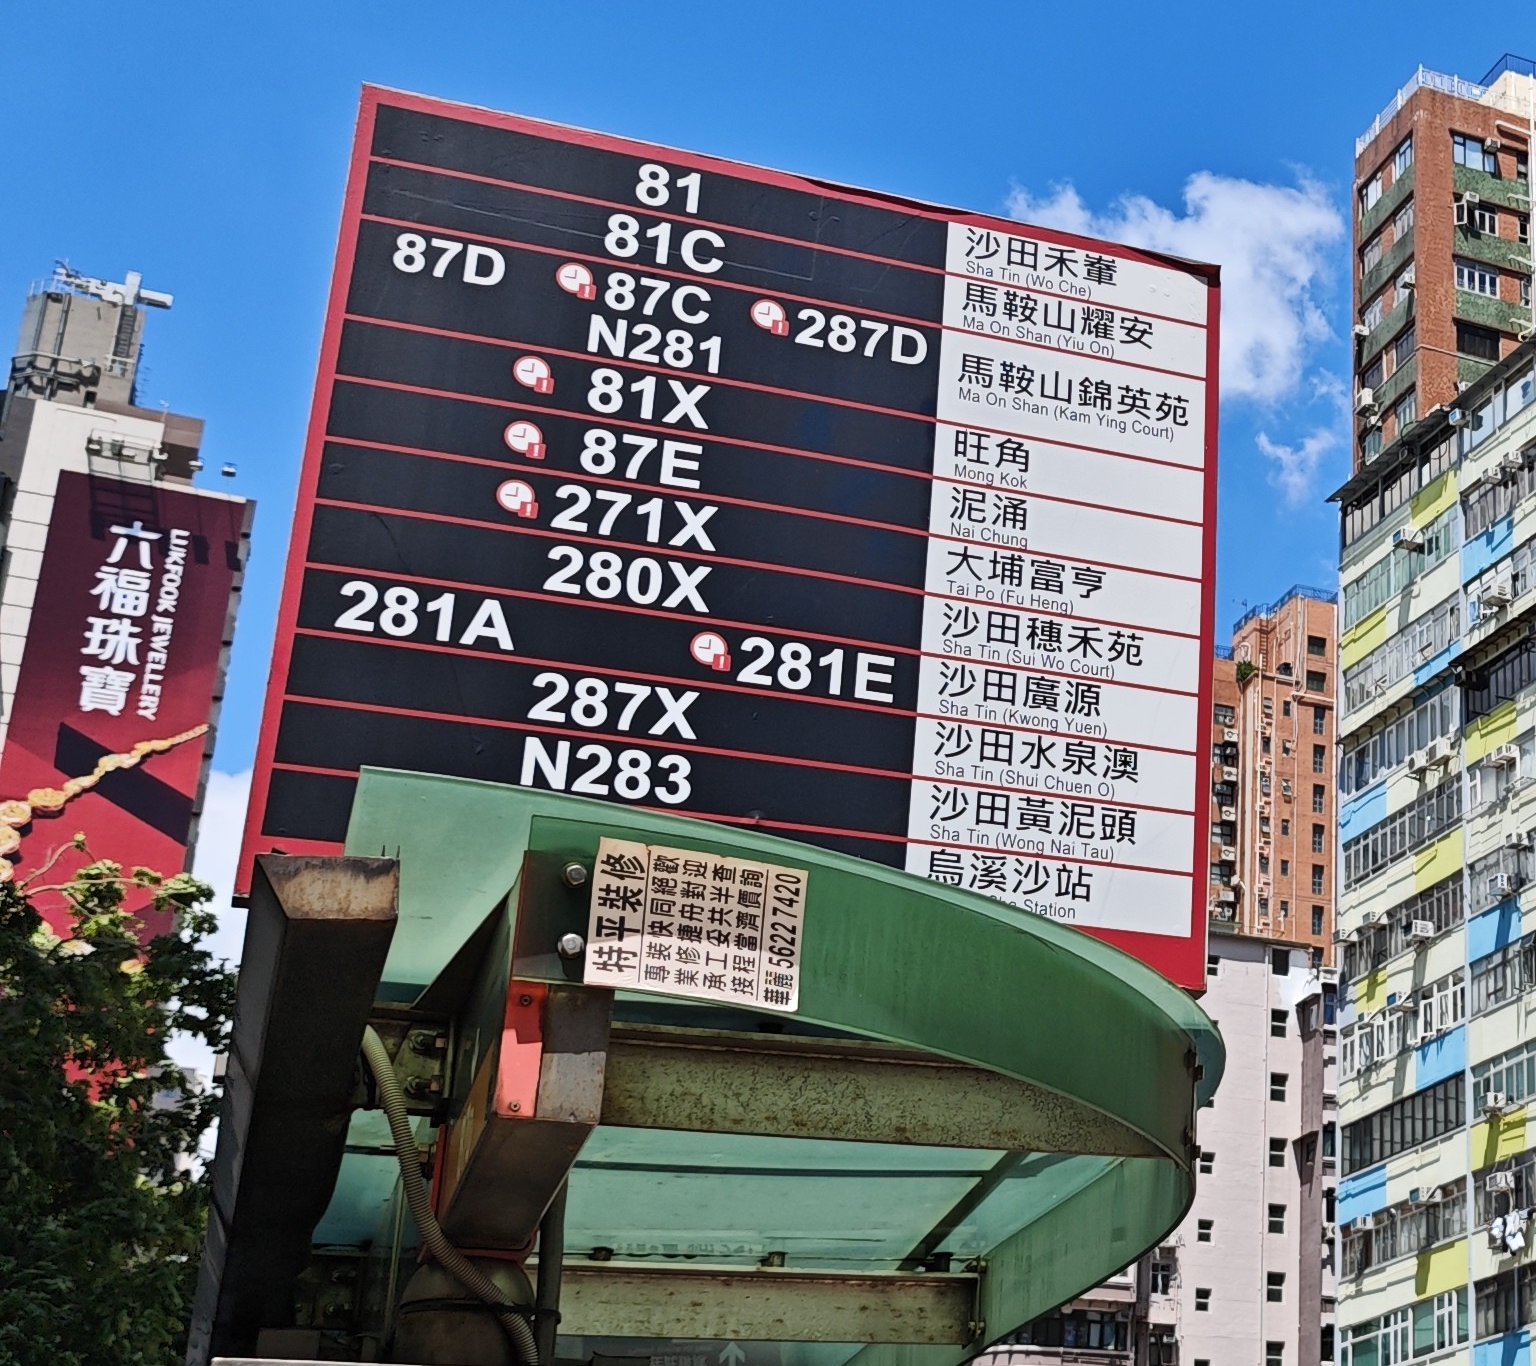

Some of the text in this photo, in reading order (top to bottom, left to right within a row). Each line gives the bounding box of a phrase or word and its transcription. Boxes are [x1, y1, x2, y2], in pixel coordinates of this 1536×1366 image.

[636, 163, 701, 214] 81
[392, 233, 506, 286] 87D
[604, 214, 726, 274] 81C
[965, 227, 1117, 286] 沙田禾輋
[604, 272, 711, 325] 87C
[966, 260, 1092, 301] Sha Tin (Wo Che)
[587, 314, 722, 374] N281
[795, 308, 928, 365] 287D
[962, 282, 1154, 350] 馬鞍山耀安
[963, 315, 1115, 360] Ma On Shan (Yiu On)
[587, 368, 711, 429] 81X
[958, 353, 1189, 427] 馬鞍山錦英苑
[958, 387, 1174, 443] Ma On Shan (Kam Ying Court)
[579, 428, 703, 490] 87E
[954, 429, 1030, 473] 旺角
[954, 463, 1028, 489] Mong Kok
[550, 484, 719, 552] 271X
[950, 486, 1028, 531] 泥涌
[950, 522, 1028, 550] Nai Chung
[543, 545, 712, 613] 280X
[946, 545, 1107, 599] 大埔富亨
[947, 579, 1074, 616] Tai Po (Fu Heng)
[79, 521, 163, 716] 六福珠寶
[334, 580, 515, 651] 281A
[941, 602, 1144, 667] 沙田穗禾苑
[136, 614, 174, 722] JEWELLERY
[737, 635, 897, 705] 281E
[942, 639, 1115, 681] Sha Tin (Sui Wo Court)
[527, 672, 700, 740] 287X
[938, 661, 1102, 718] 沙田廣源
[938, 699, 1108, 739] Sha Tin (Kwong Yuen)
[520, 736, 692, 805] N283
[934, 721, 1139, 783] 沙田水泉澳
[934, 760, 1115, 801] Sha Tin (Shui Chuen O)
[929, 784, 1138, 845] 沙田黃泥頭
[930, 824, 1114, 862] Sha Tin (Wong Nai Tau)
[927, 848, 1093, 903] 烏溪沙站
[592, 854, 645, 972] 特平裝修
